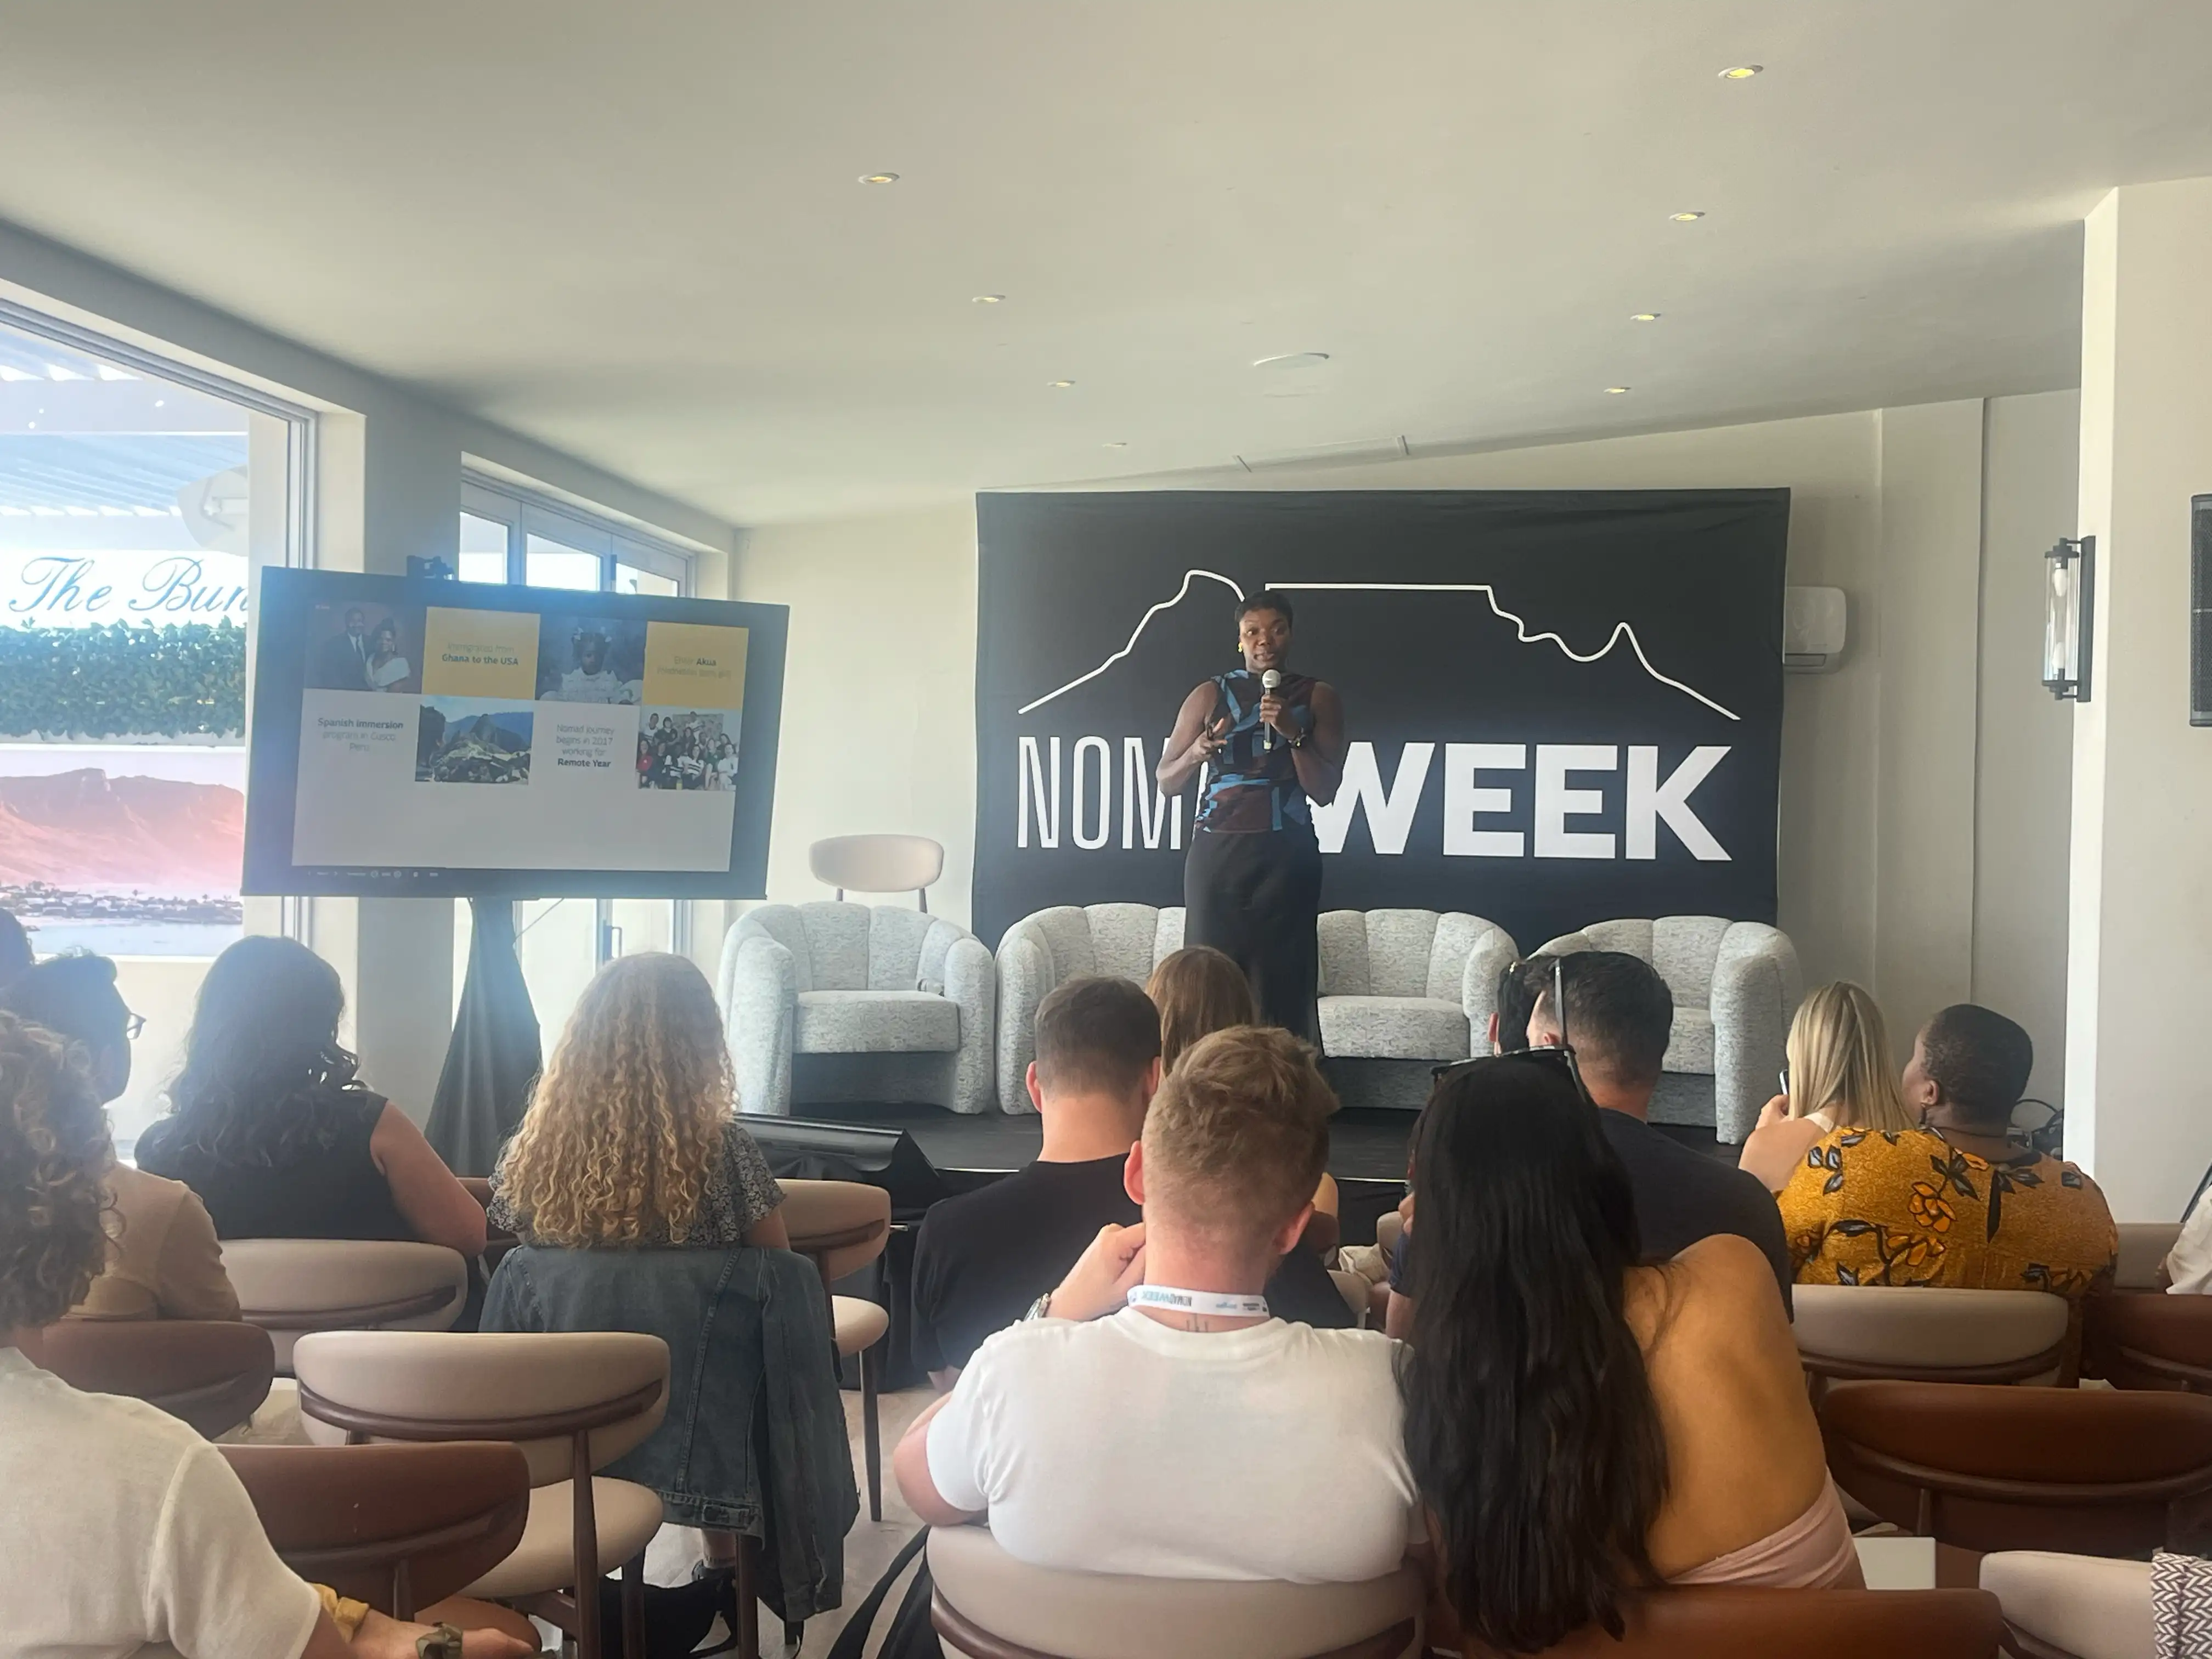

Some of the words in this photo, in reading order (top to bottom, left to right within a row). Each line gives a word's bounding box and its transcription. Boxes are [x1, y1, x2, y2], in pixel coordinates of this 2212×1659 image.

[9, 557, 112, 612] The
[442, 653, 469, 663] Ghana
[483, 656, 498, 664] the
[500, 657, 518, 665] USA
[696, 658, 716, 666] Akua
[318, 718, 354, 728] Spanish
[557, 724, 584, 733] Nomad
[556, 736, 580, 746] begins
[592, 737, 613, 745] 2017
[557, 758, 591, 767] Remote
[1017, 736, 1208, 850] NOM
